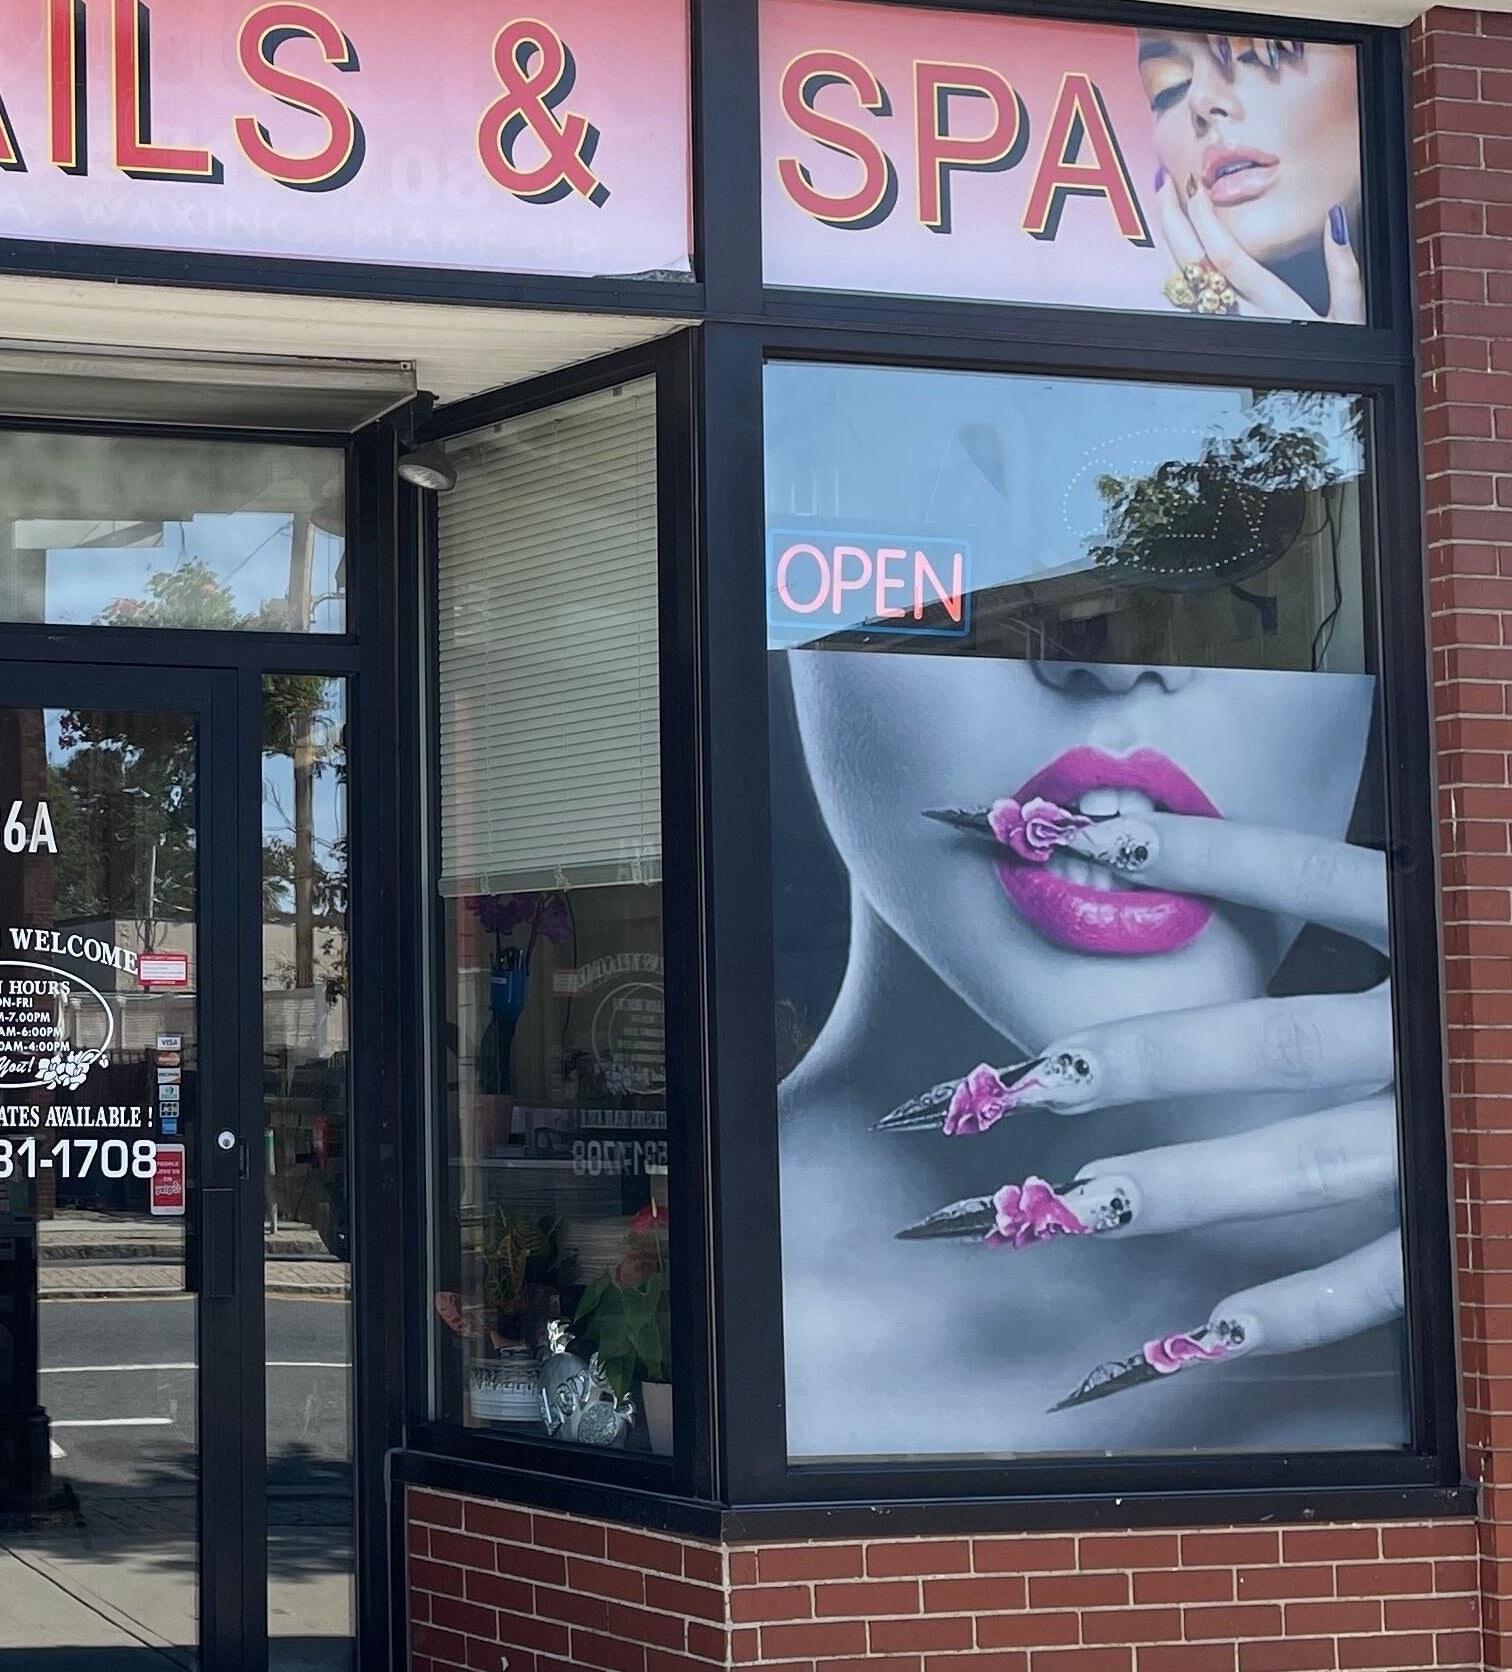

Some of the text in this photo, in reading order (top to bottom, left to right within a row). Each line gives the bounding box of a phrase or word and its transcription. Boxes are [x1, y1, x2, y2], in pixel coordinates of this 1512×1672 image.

[476, 17, 612, 209] &
[776, 48, 1155, 248] SPA
[775, 543, 965, 623] OPEN
[9, 928, 138, 976] WELCOME
[8, 980, 71, 995] HOURS
[44, 1106, 142, 1128] AVAILABLE
